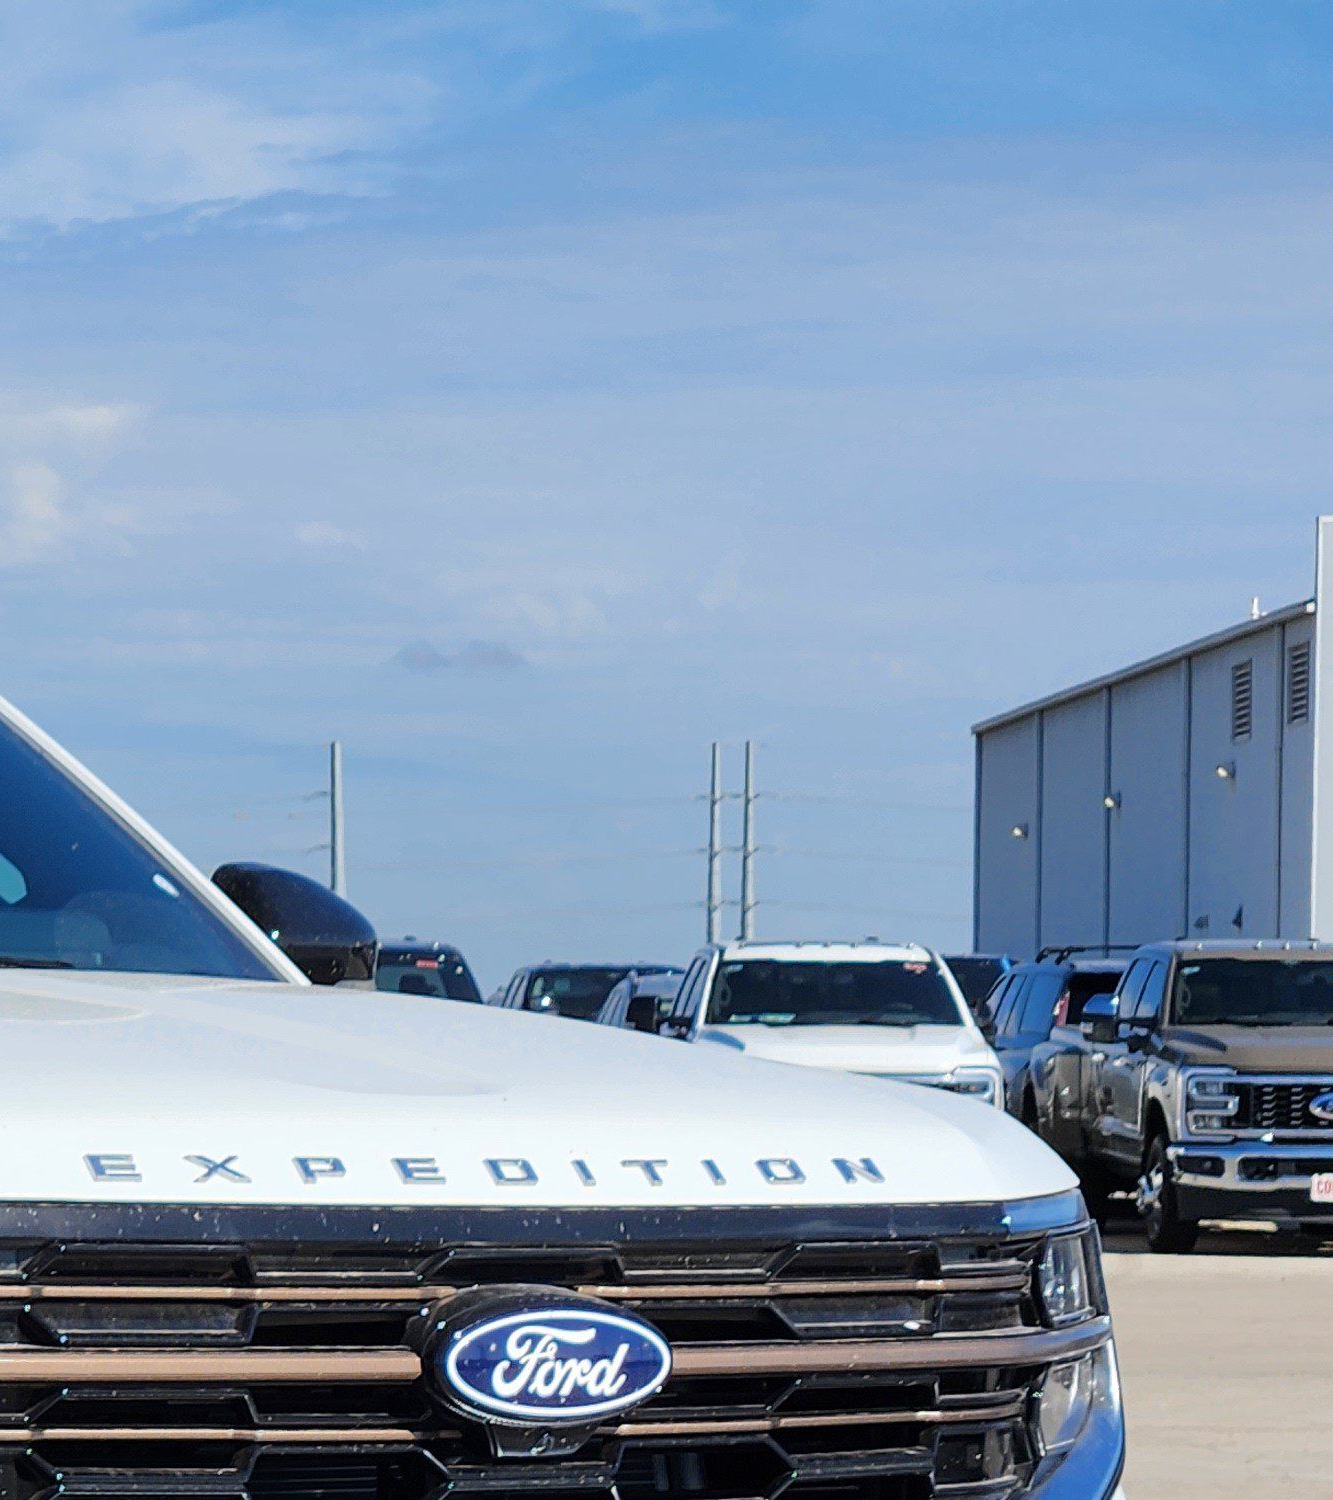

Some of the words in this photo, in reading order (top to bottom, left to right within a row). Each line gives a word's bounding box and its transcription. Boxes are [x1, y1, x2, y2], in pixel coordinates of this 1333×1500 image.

[84, 1152, 886, 1186] EXPEDITION
[1317, 1180, 1333, 1195] CO
[491, 1326, 629, 1397] Ford
